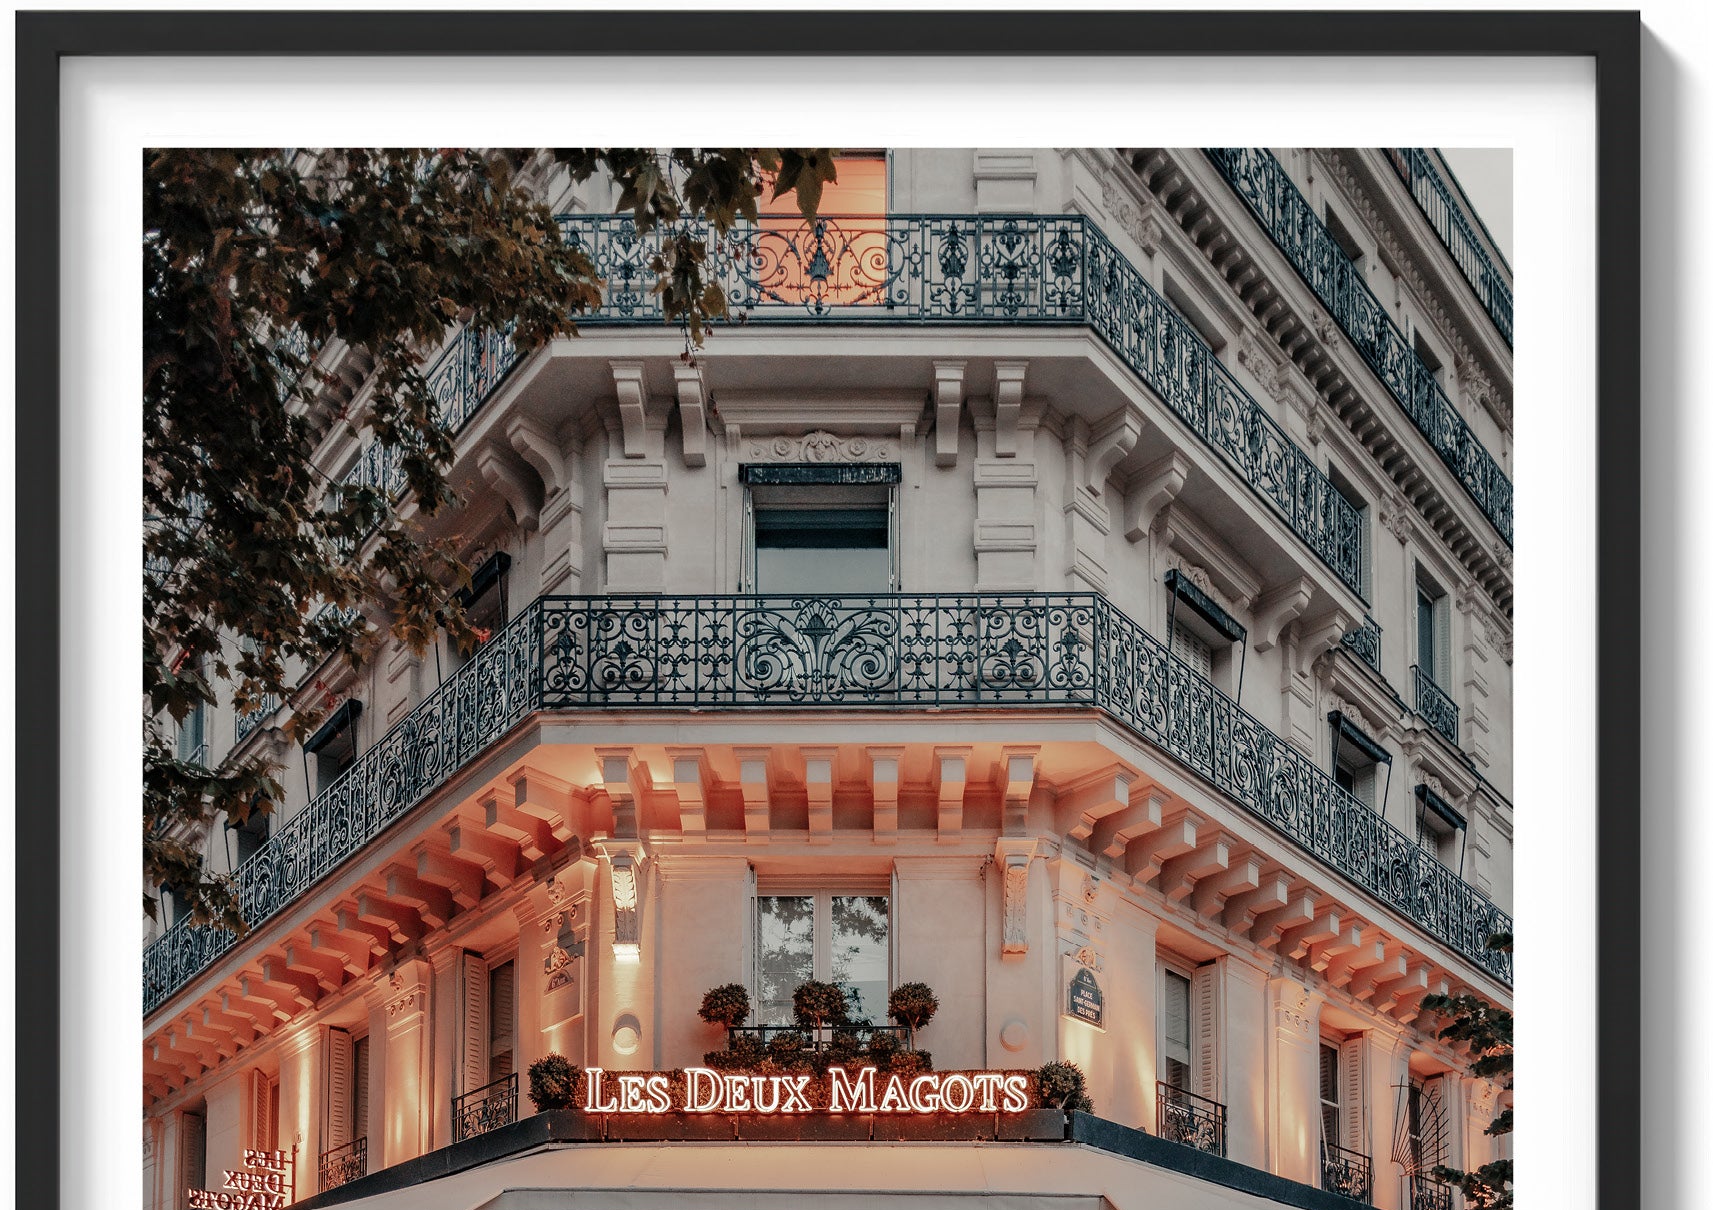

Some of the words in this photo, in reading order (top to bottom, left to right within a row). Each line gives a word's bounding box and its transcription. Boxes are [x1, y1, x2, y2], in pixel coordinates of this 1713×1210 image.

[1080, 989, 1093, 1000] PLACE
[1077, 1006, 1086, 1016] DES
[584, 1067, 671, 1113] LES
[683, 1067, 813, 1113] DEUX
[828, 1067, 1028, 1113] MAGOTS
